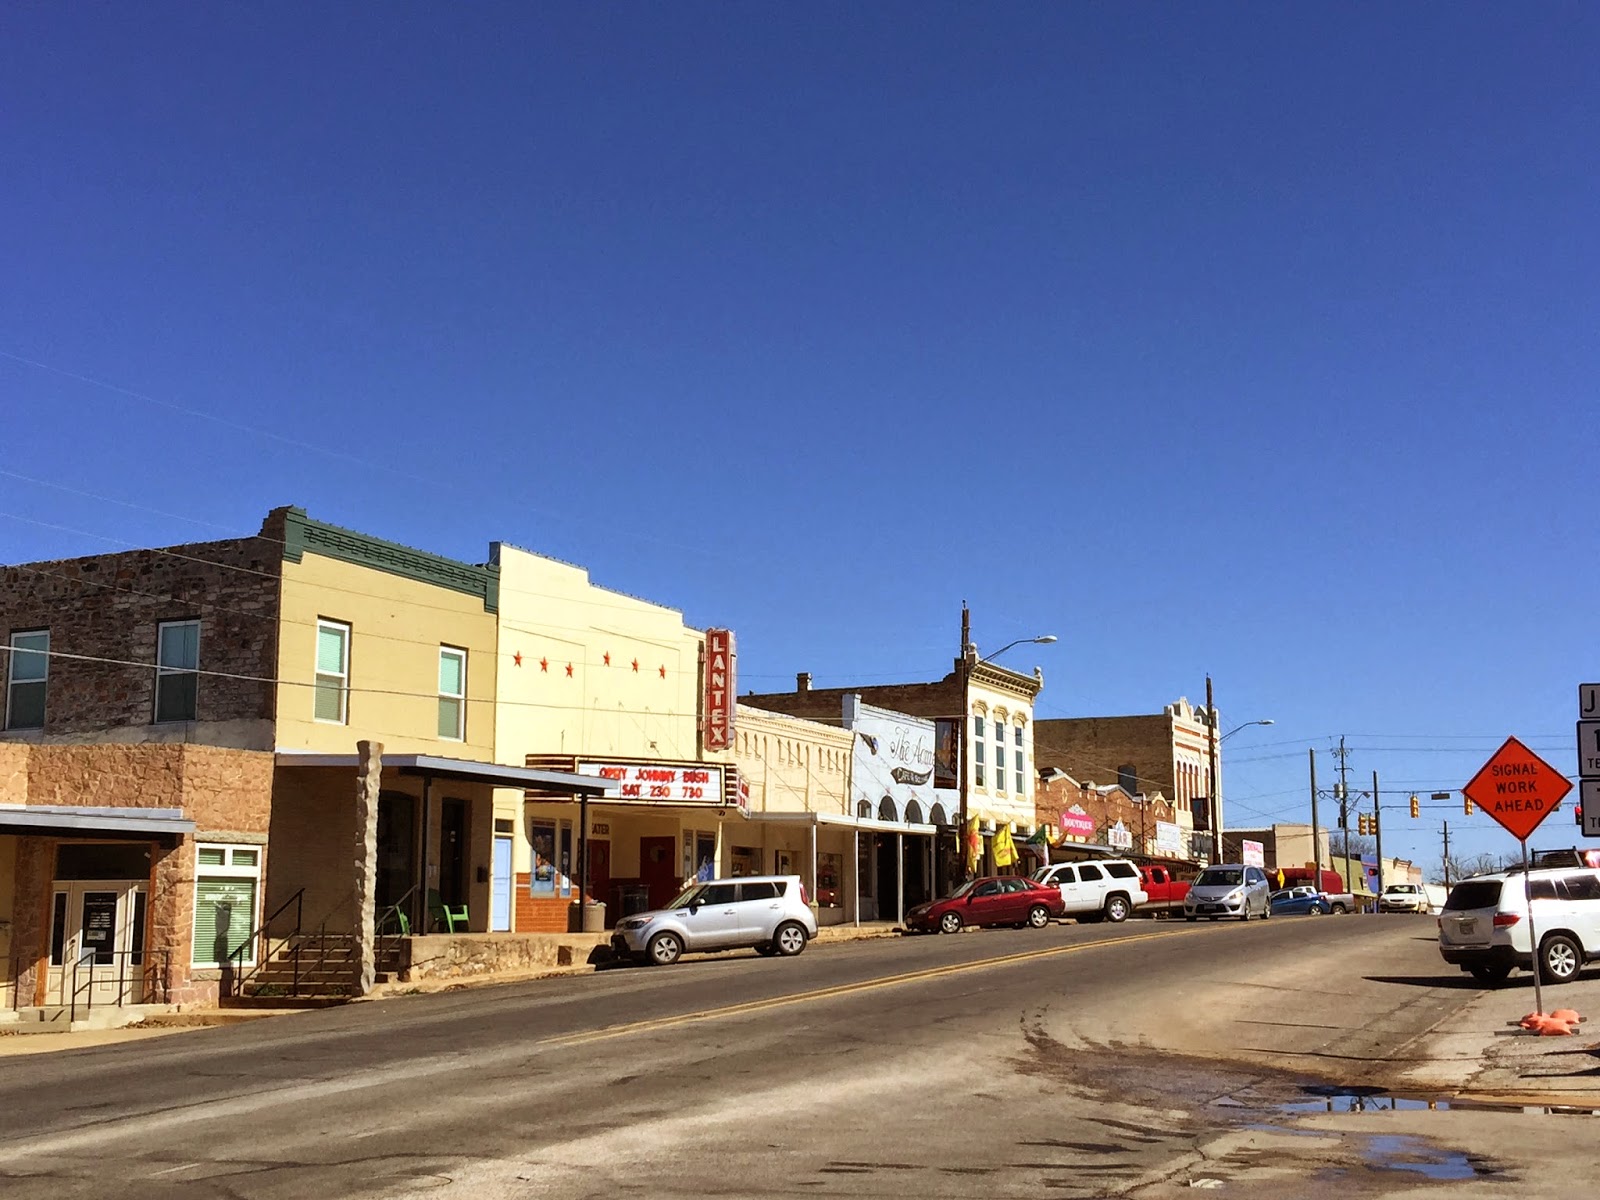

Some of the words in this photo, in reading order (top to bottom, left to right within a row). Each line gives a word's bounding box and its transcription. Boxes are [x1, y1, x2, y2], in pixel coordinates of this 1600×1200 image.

[711, 637, 726, 743] LANTEX
[635, 768, 676, 783] JOHNNY
[683, 771, 709, 784] BUSH
[1492, 764, 1538, 777] SIGNAL
[622, 784, 641, 797] SAT
[650, 785, 671, 798] 230
[682, 786, 703, 799] 730
[1496, 781, 1537, 794] WORK
[1494, 799, 1544, 812] AHEAD
[592, 823, 609, 835] ATER
[1064, 817, 1093, 830] BOUTIQUE
[1113, 831, 1128, 845] BAR
